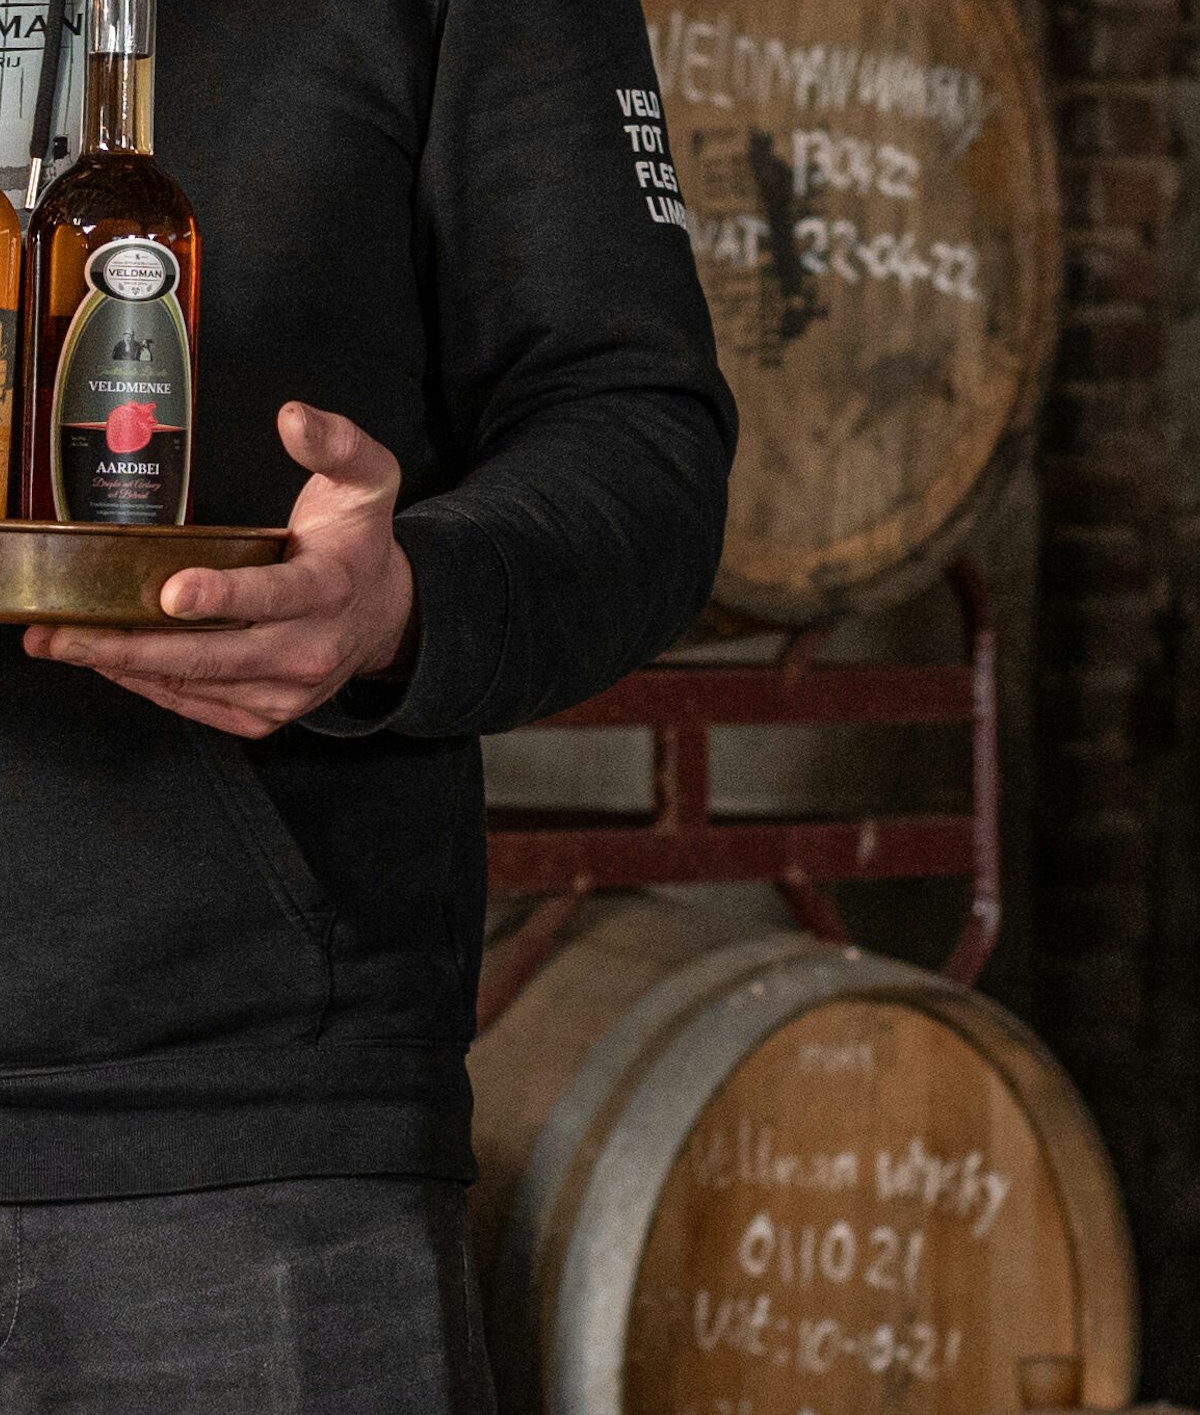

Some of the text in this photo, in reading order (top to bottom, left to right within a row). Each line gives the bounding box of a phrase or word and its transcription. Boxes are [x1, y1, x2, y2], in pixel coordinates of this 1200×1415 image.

[615, 89, 661, 119] VELD
[623, 125, 664, 154] TOT
[108, 268, 163, 279] VELDMAN
[88, 380, 172, 395] VELDMENKE
[96, 461, 160, 476] AARDBEI
